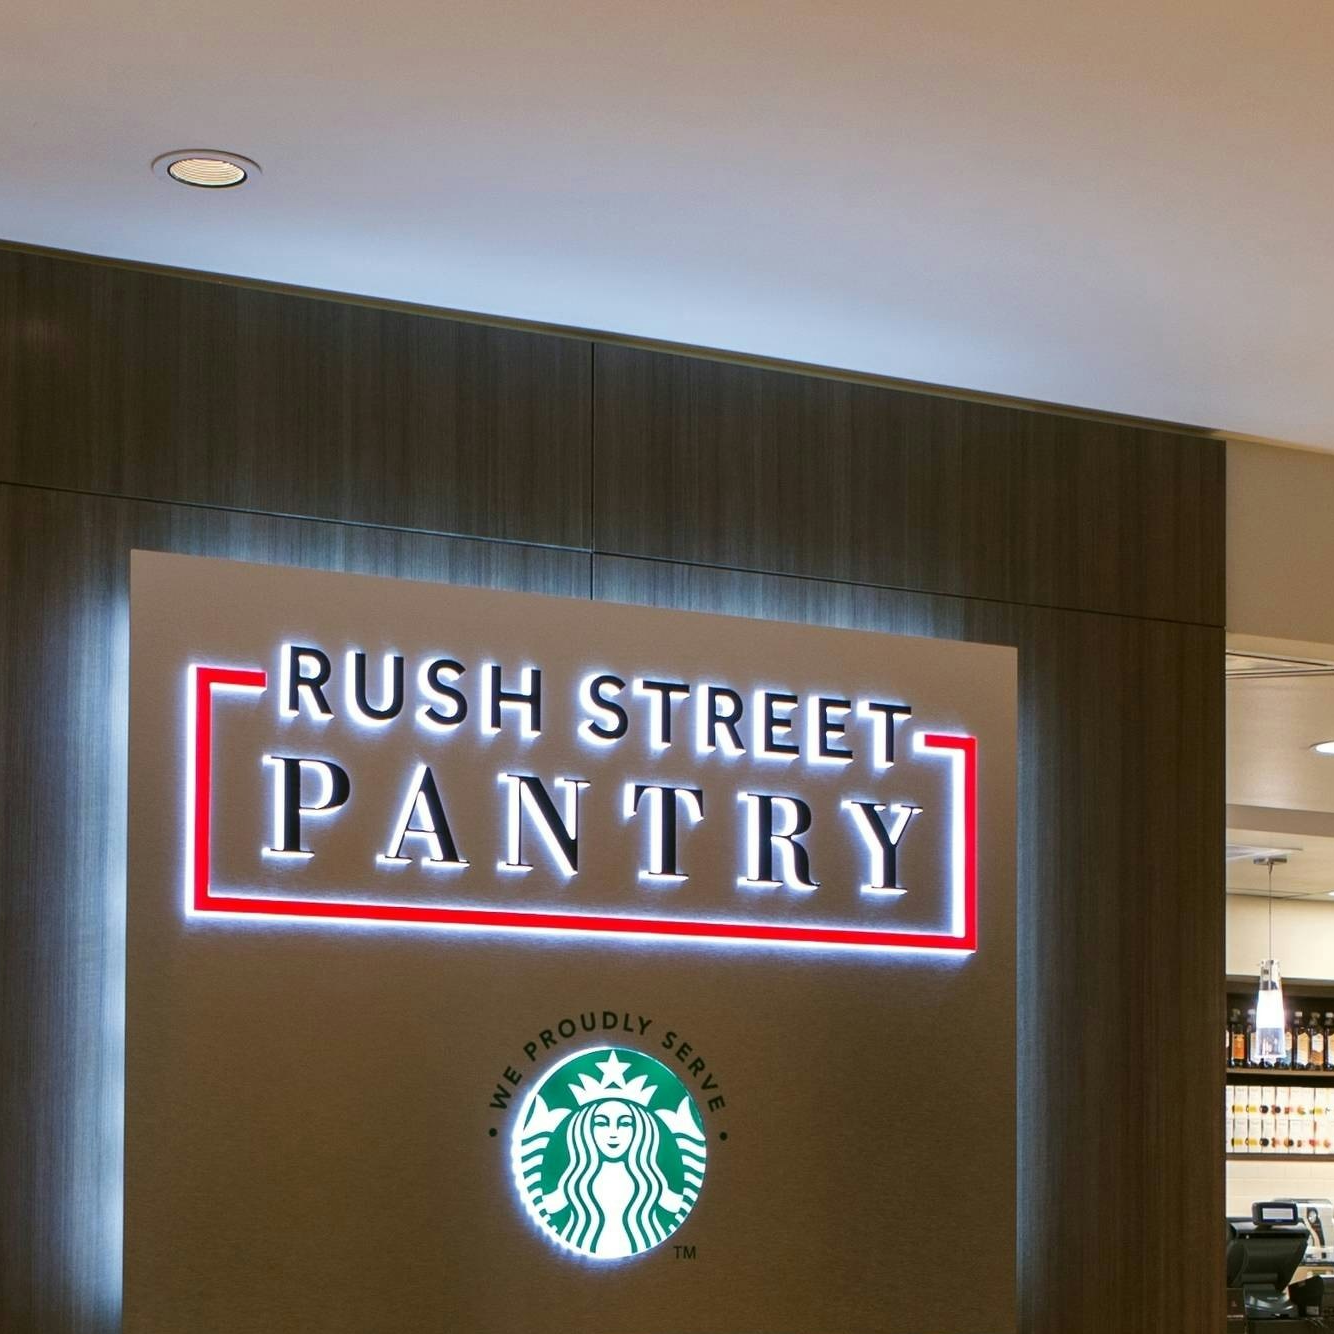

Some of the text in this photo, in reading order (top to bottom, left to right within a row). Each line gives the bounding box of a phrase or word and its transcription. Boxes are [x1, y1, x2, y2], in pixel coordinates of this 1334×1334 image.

[282, 645, 912, 768] RUSH STREET
[264, 755, 924, 895] PANTRY
[489, 1011, 726, 1113] WE PROUDLY SERVE
[673, 1246, 697, 1260] TM
